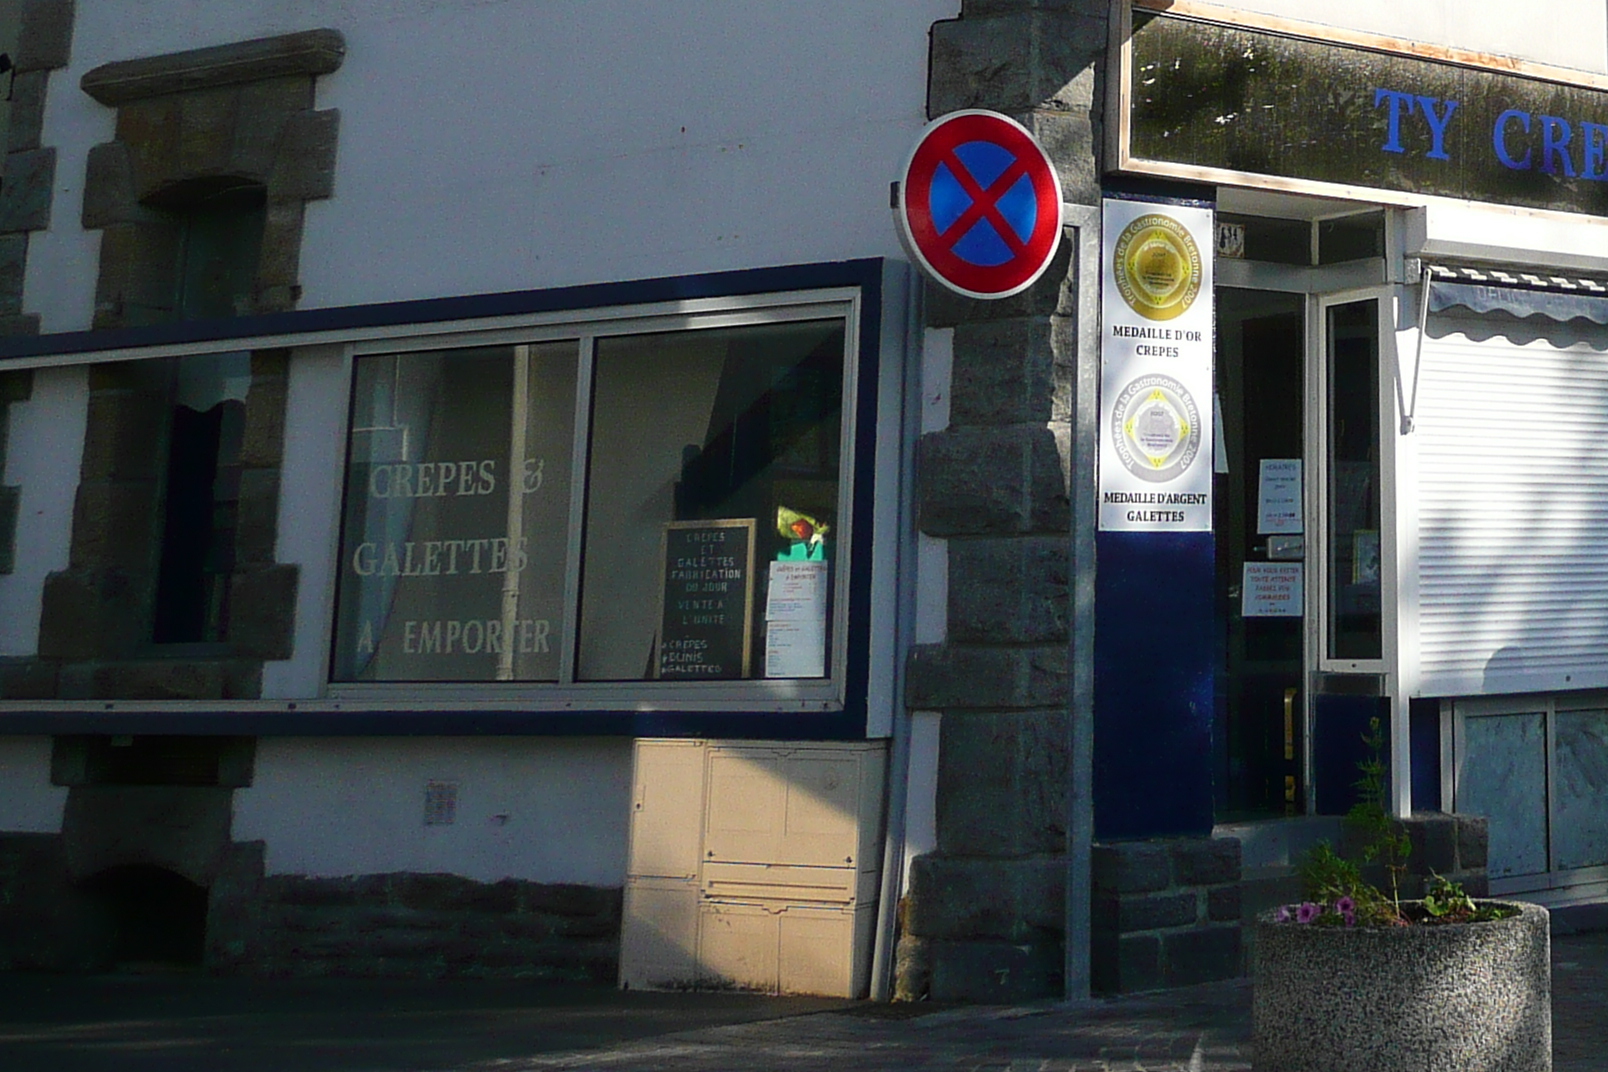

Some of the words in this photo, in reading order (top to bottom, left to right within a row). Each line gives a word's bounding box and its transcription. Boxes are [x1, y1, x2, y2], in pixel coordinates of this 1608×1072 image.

[1374, 87, 1459, 161] TY
[1130, 217, 1185, 237] Gastronomie
[1183, 236, 1200, 282] Bretonne
[1112, 325, 1172, 340] MEDAILLE
[1175, 329, 1202, 342] D'OR
[1136, 345, 1179, 358] CREPES
[1128, 377, 1184, 396] Gastronomie
[1182, 393, 1198, 442] Bretonne
[1180, 444, 1197, 470] 2007
[371, 460, 497, 498] CREPES
[520, 458, 545, 494] &
[1104, 491, 1156, 504] MEDAILLE
[1157, 492, 1208, 505] D'ARGENT
[1127, 510, 1185, 522] GALETTES
[353, 536, 528, 577] GALETTES
[677, 556, 734, 568] GALETTES
[357, 620, 374, 653] A
